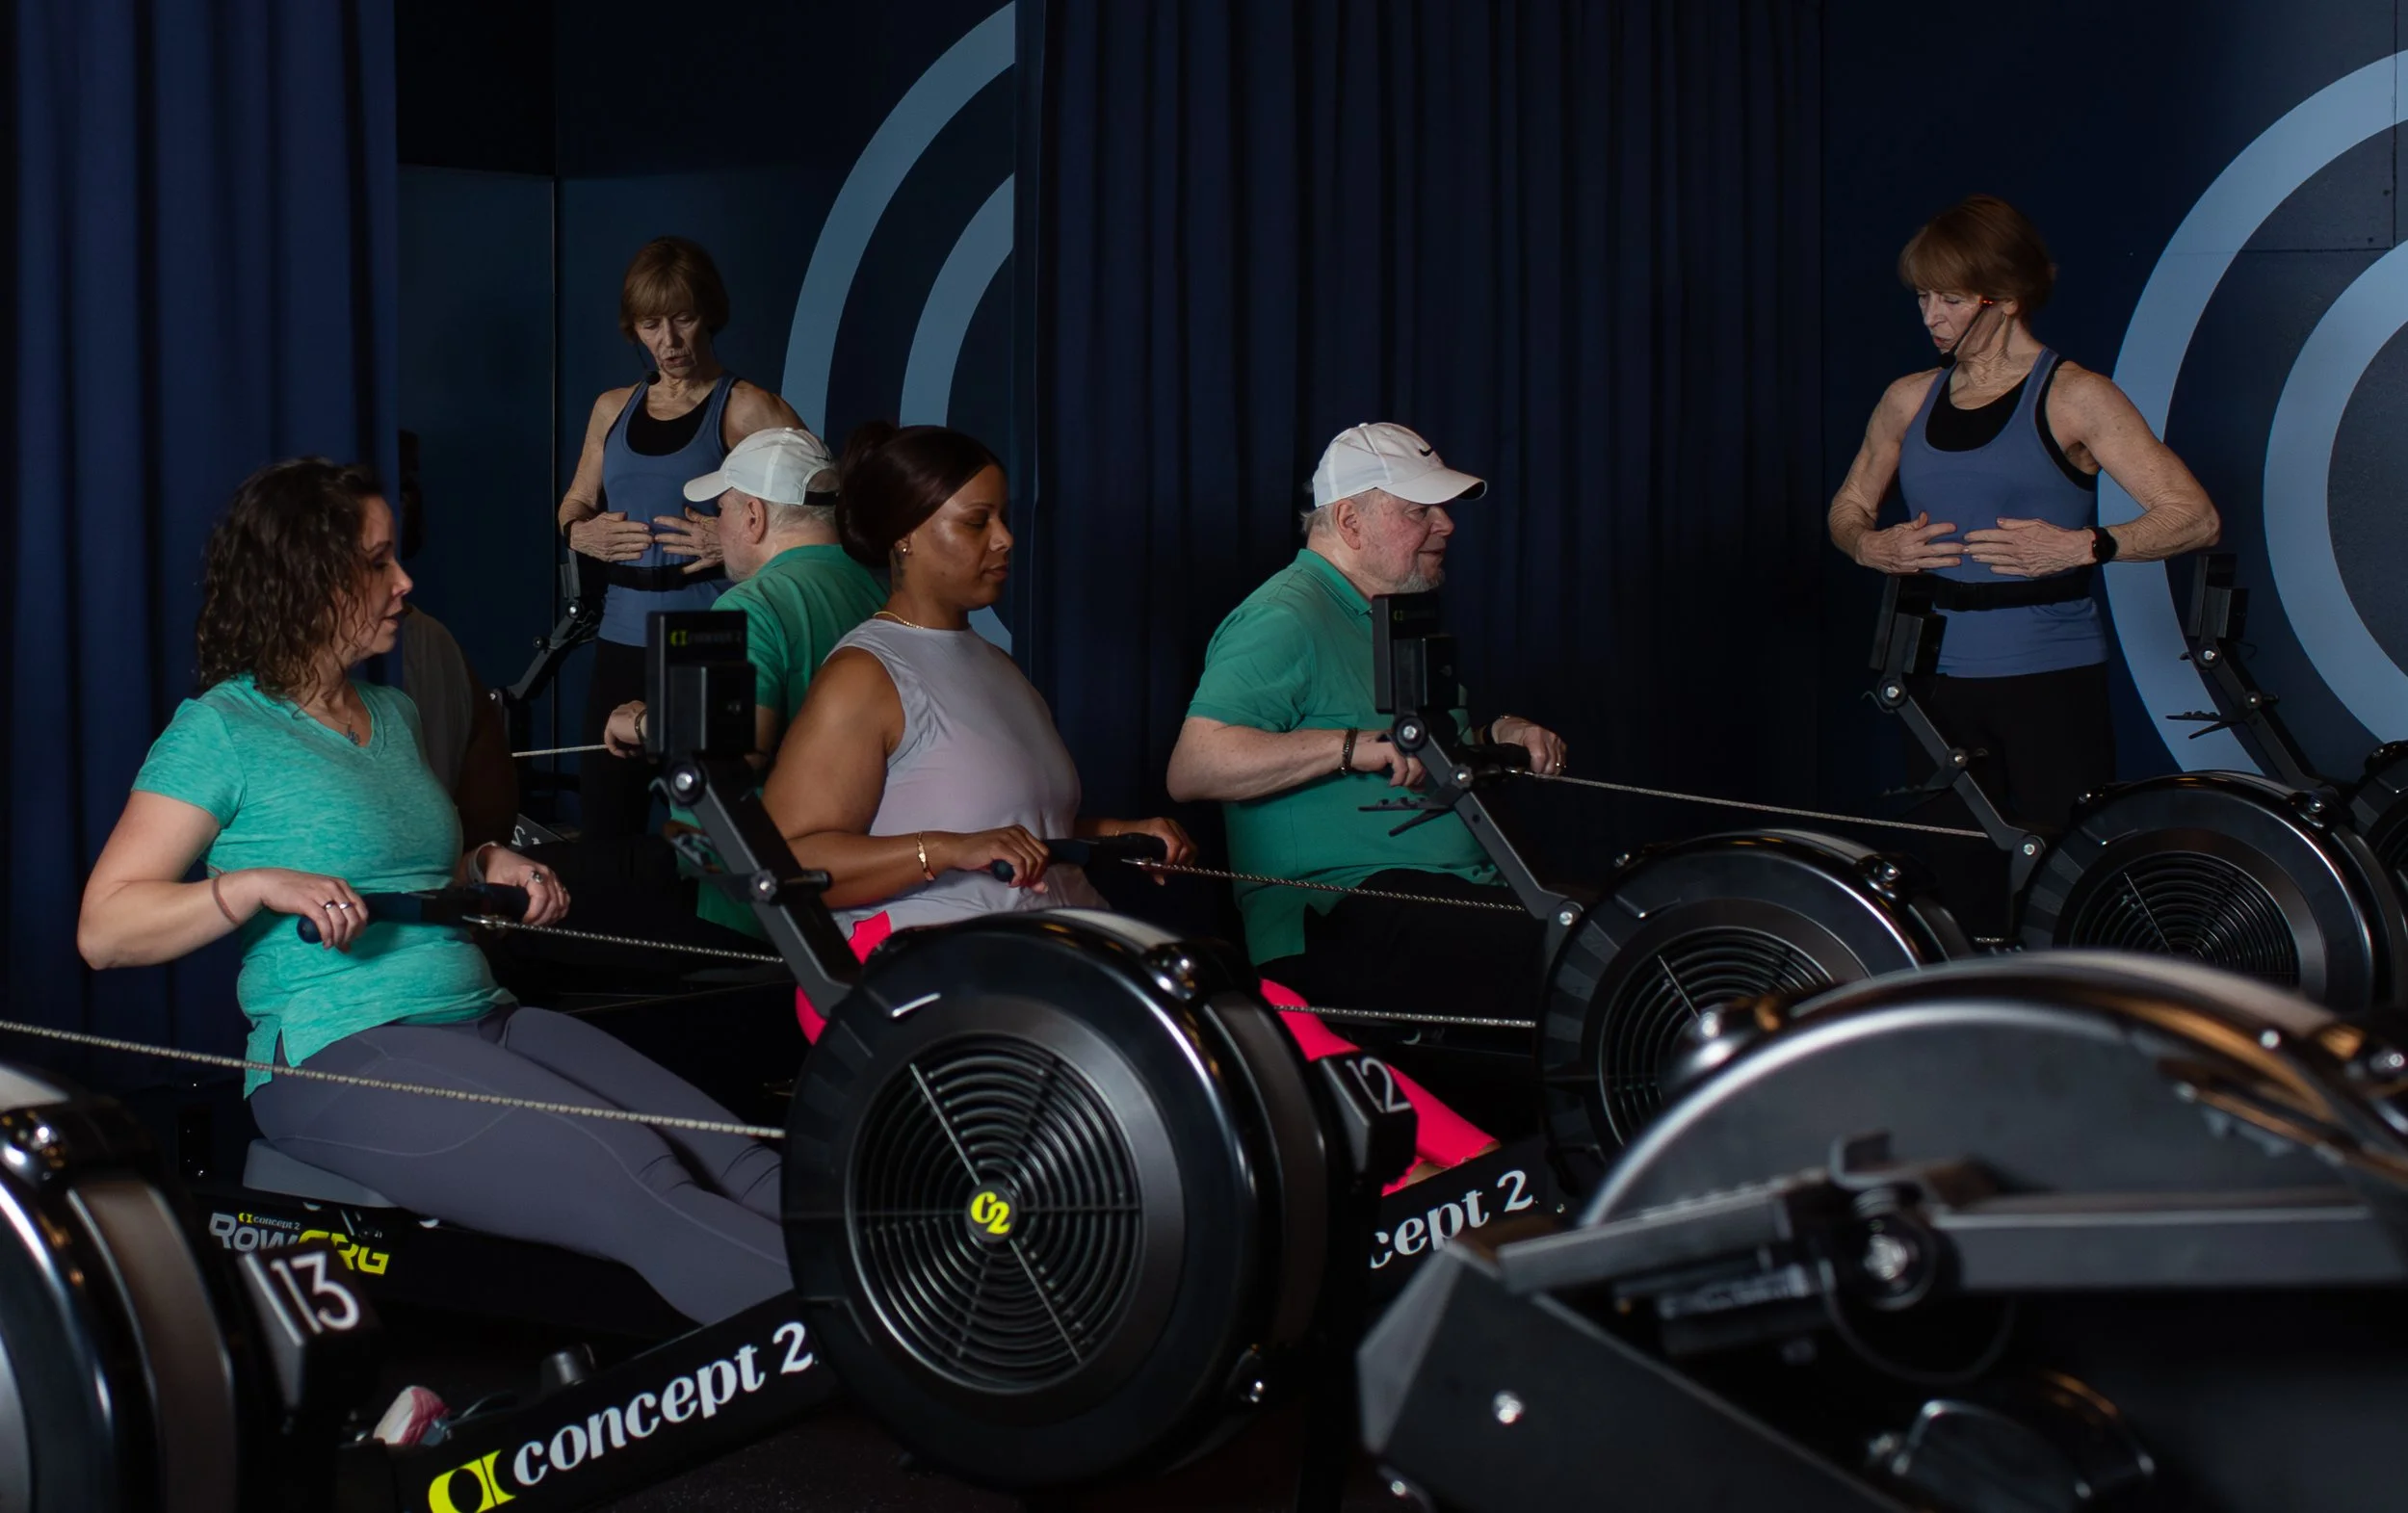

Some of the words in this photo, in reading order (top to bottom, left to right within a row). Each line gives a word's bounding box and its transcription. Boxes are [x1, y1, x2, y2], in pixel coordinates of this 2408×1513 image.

[1345, 1056, 1412, 1113] 12
[1497, 1169, 1534, 1213] 2
[270, 1250, 360, 1335] 13
[512, 1343, 767, 1487] concept
[772, 1320, 814, 1375] 2
